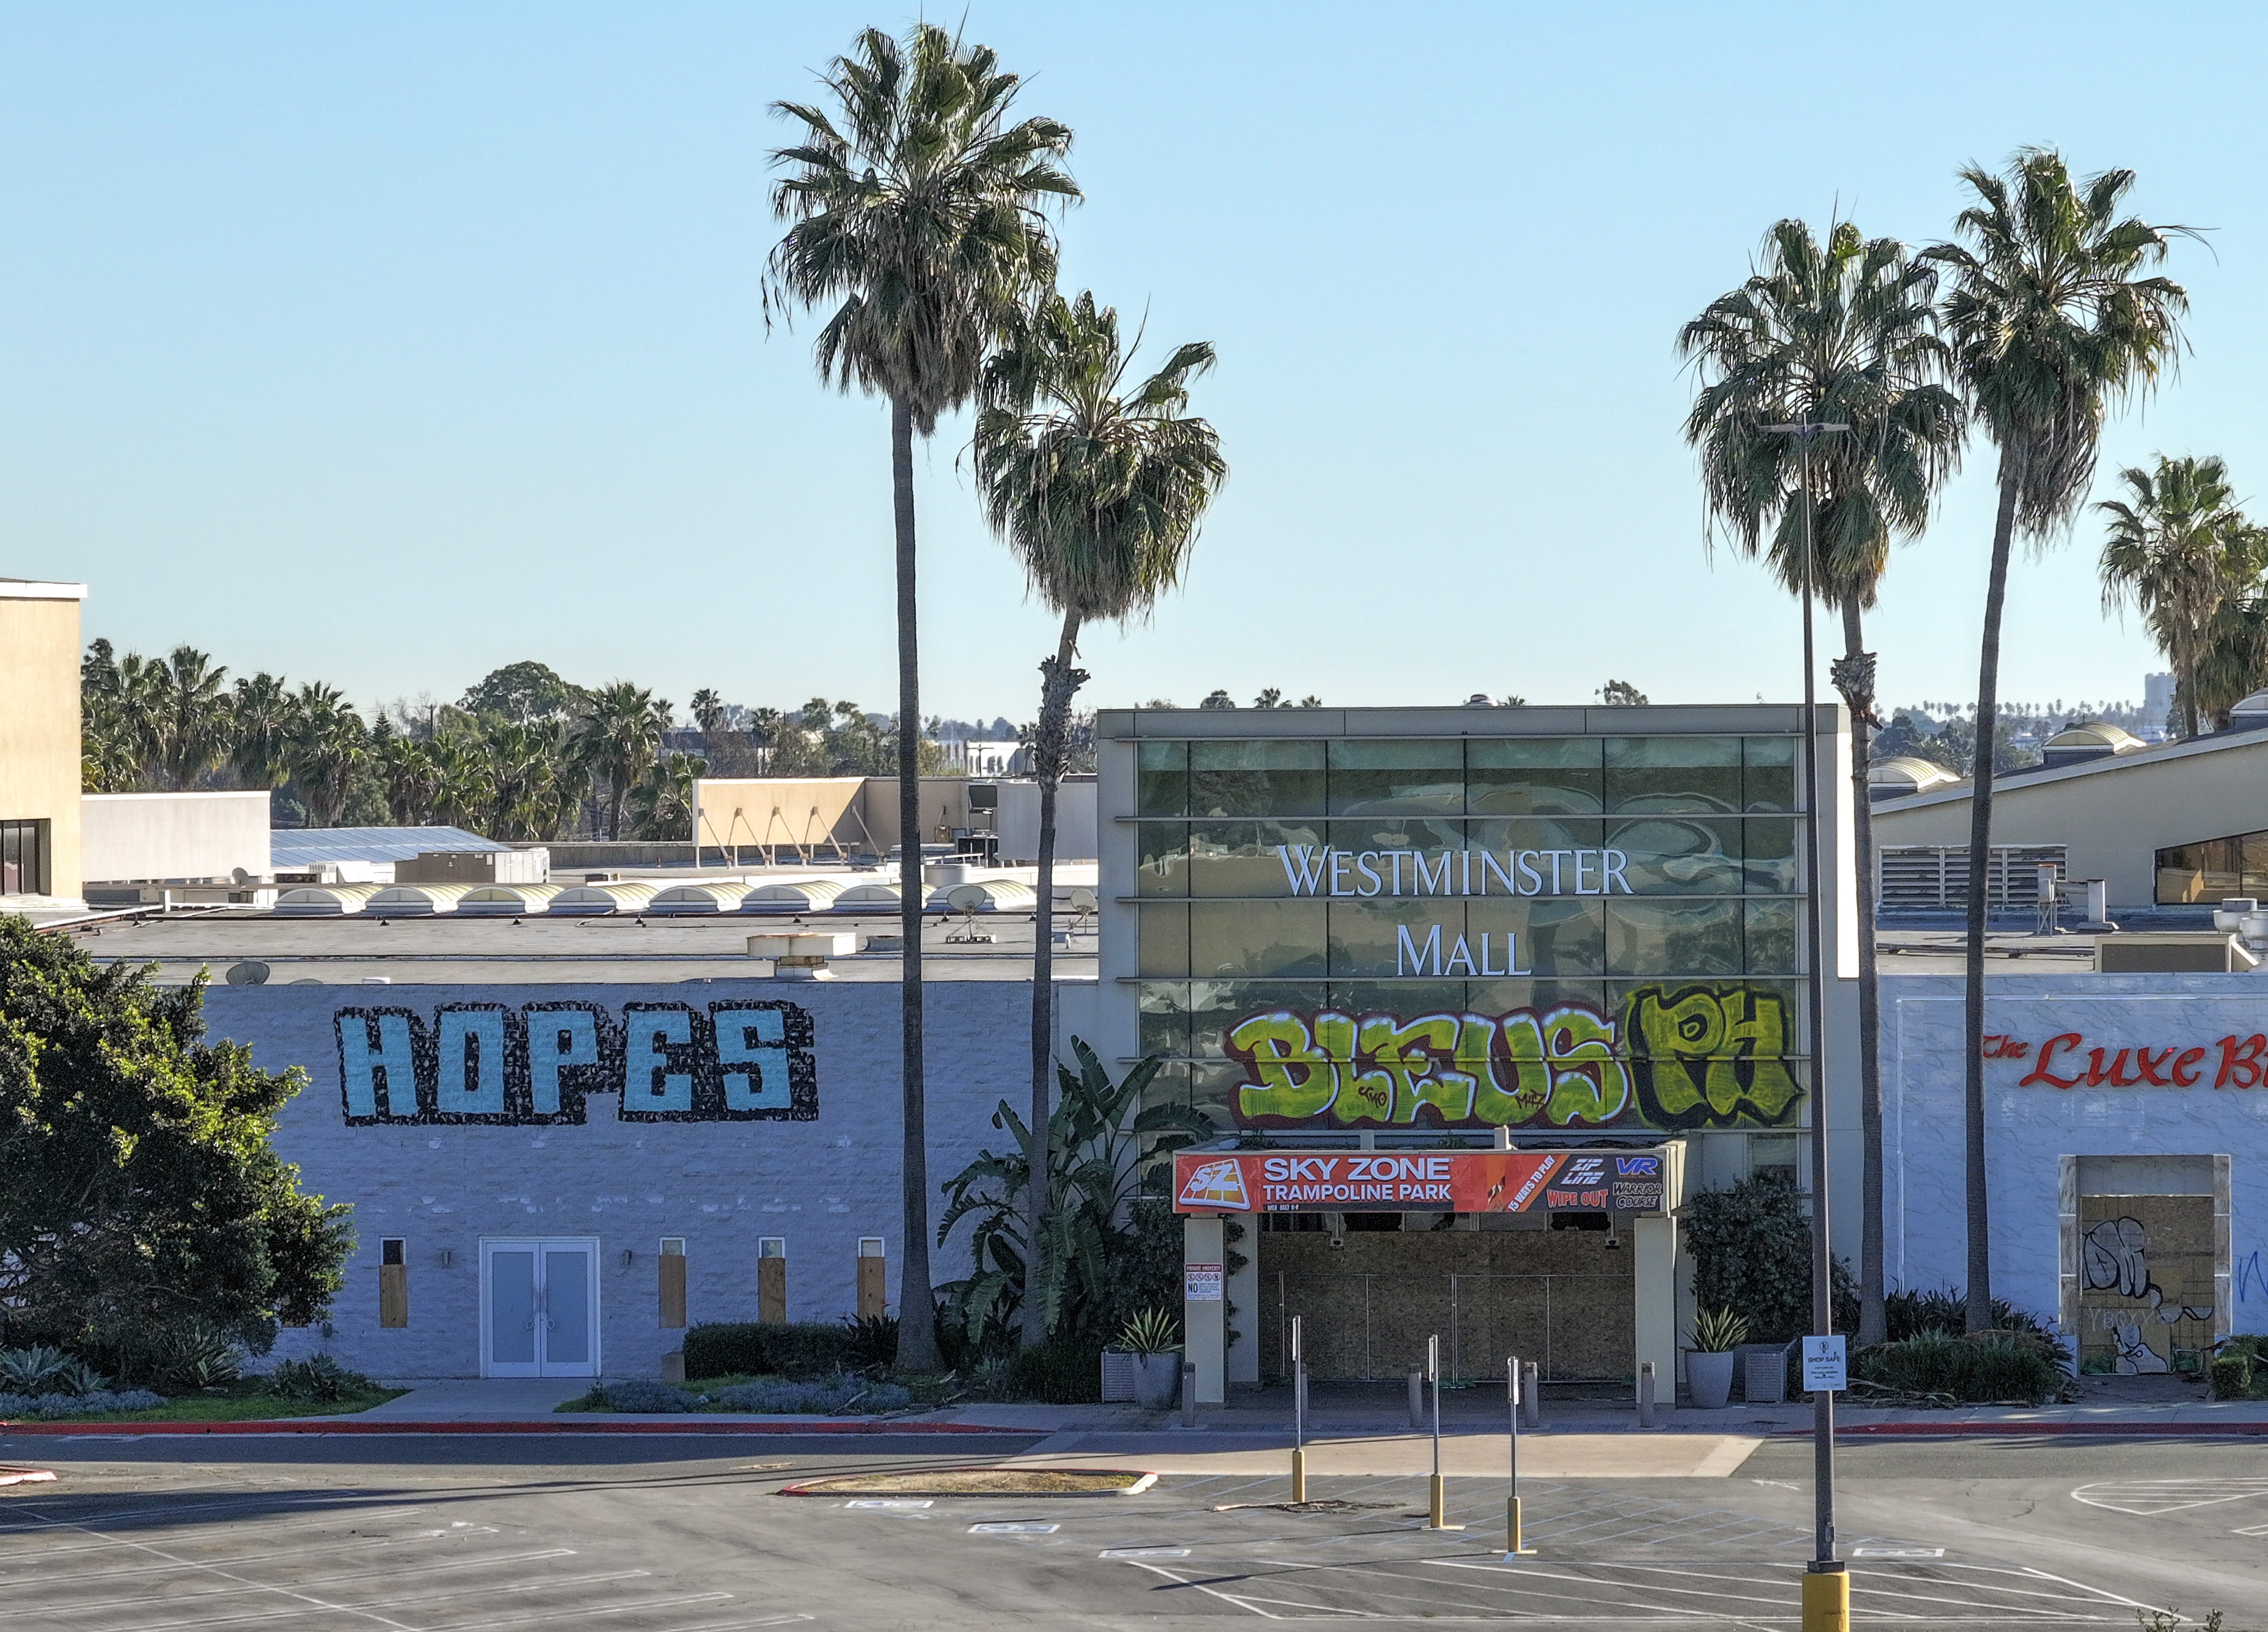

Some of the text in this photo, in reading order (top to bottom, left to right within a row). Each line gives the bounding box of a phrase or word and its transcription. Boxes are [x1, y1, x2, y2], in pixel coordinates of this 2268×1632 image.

[1276, 845, 1634, 897] WESTMINSTER
[1396, 924, 1532, 976] MALL
[334, 1000, 819, 1126] HOPES
[1983, 1033, 2268, 1089] The Luxe B
[1264, 1158, 1451, 1181] SKY ZONE
[1570, 1158, 1604, 1171] ZIP
[1616, 1158, 1658, 1175] VR
[1191, 1164, 1239, 1191] SZ
[1508, 1155, 1556, 1212] 15 WAYS TO PLAY
[1560, 1172, 1605, 1185] LINE
[1263, 1184, 1452, 1201] TRAMPOLINE PARK
[1546, 1188, 1609, 1209] WIPE OUT
[1613, 1182, 1663, 1196] WARRIOR
[1616, 1195, 1658, 1209] COURSE
[1188, 1283, 1198, 1293] NO
